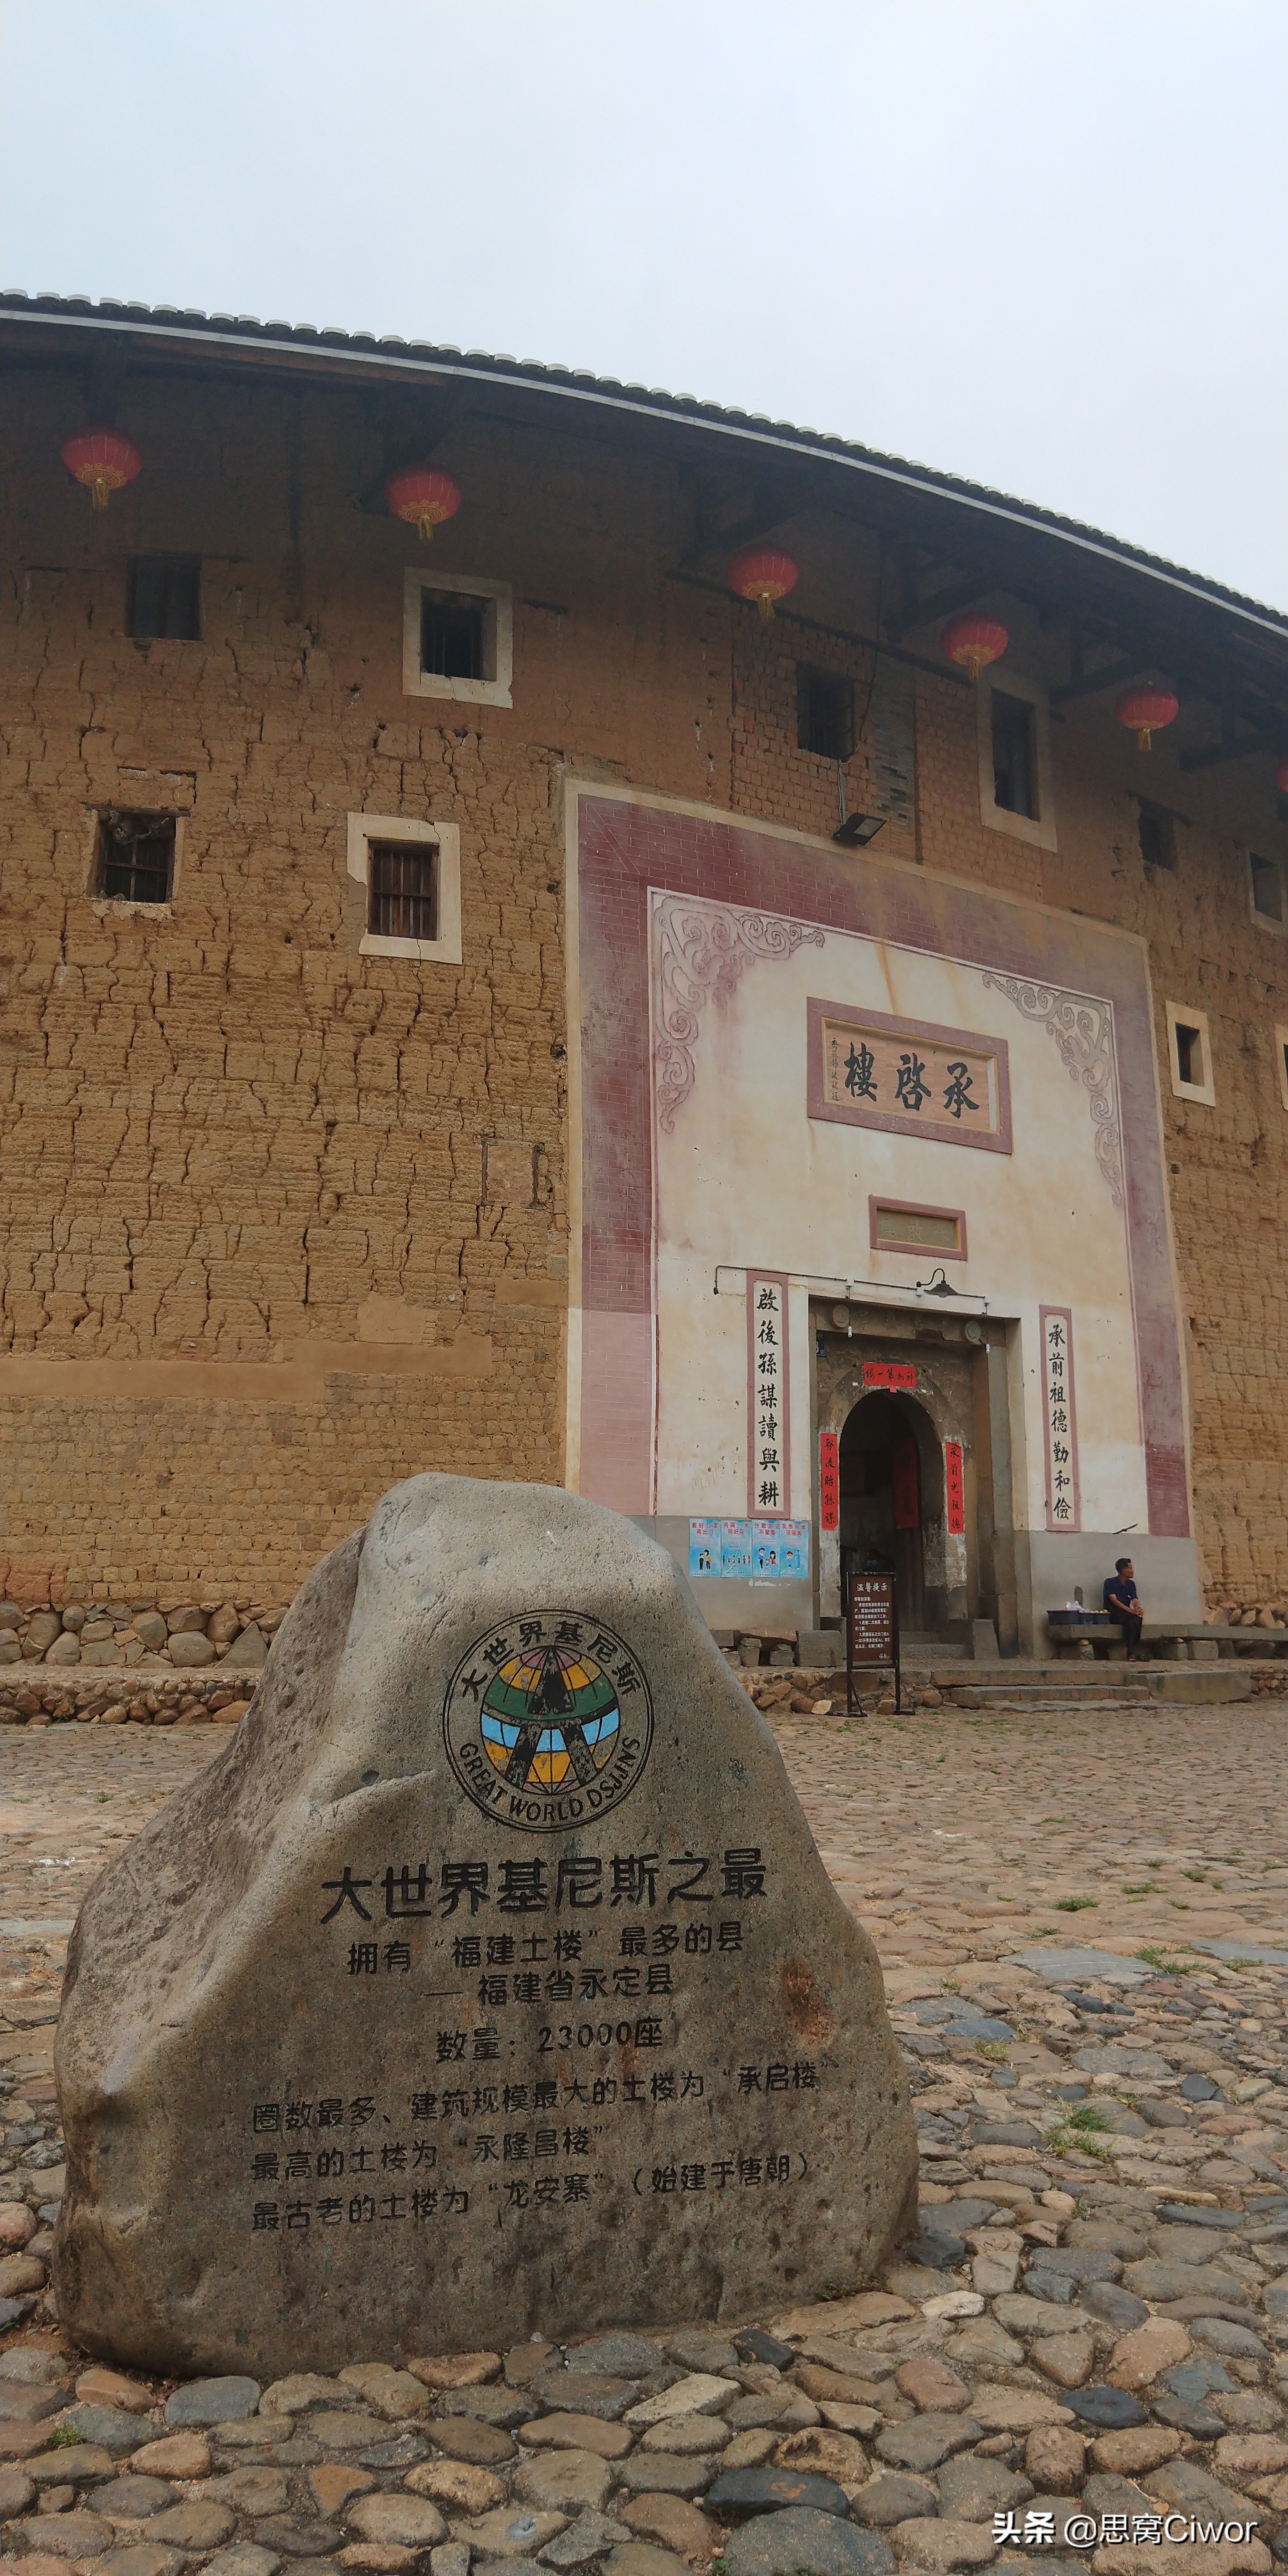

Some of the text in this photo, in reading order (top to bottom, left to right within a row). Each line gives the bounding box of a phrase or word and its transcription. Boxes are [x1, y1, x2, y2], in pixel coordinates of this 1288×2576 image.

[857, 1582, 888, 1592] 温馨提示
[461, 1620, 641, 1702] 大世界基尼斯
[460, 1737, 641, 1822] GREAT WORLD DSJJNS
[320, 1847, 767, 1924] 大世界基尼斯之最
